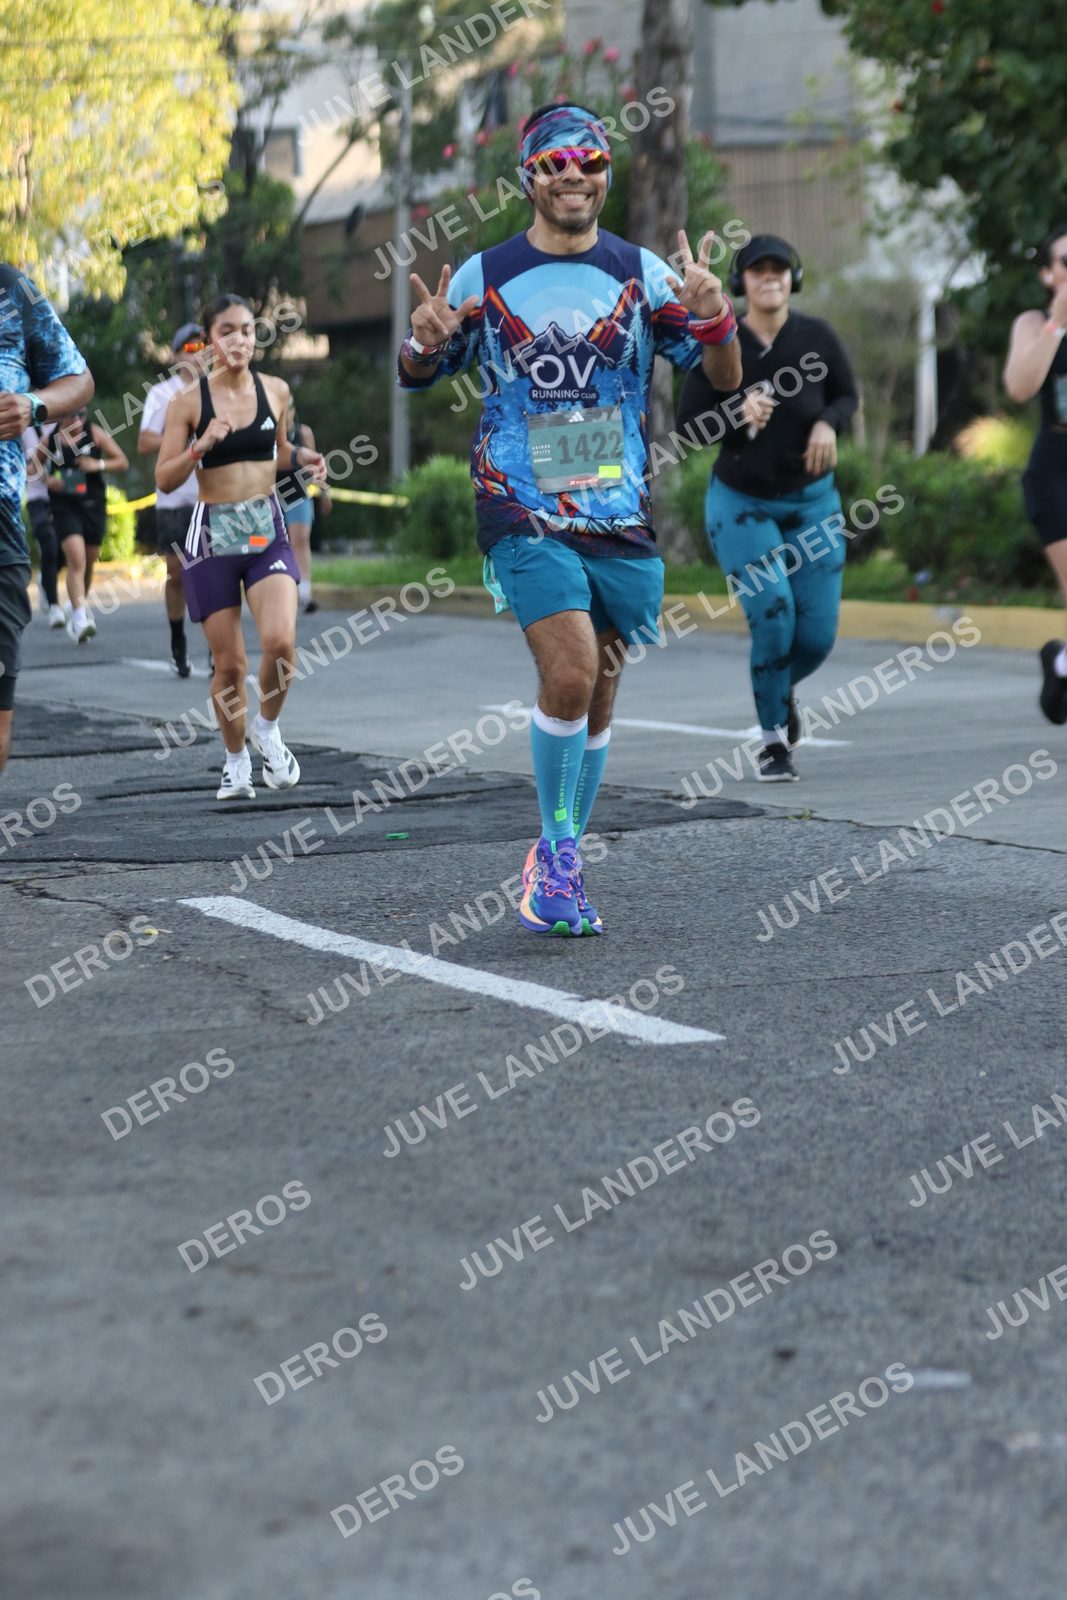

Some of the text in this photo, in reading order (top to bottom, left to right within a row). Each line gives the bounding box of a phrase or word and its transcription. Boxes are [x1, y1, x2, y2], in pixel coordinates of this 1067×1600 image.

[530, 354, 598, 389] OV
[532, 389, 580, 400] RUNNING
[557, 430, 623, 465] 1422
[558, 748, 570, 808] COMPRESSPORT
[573, 763, 590, 822] COMPRESSPORT
